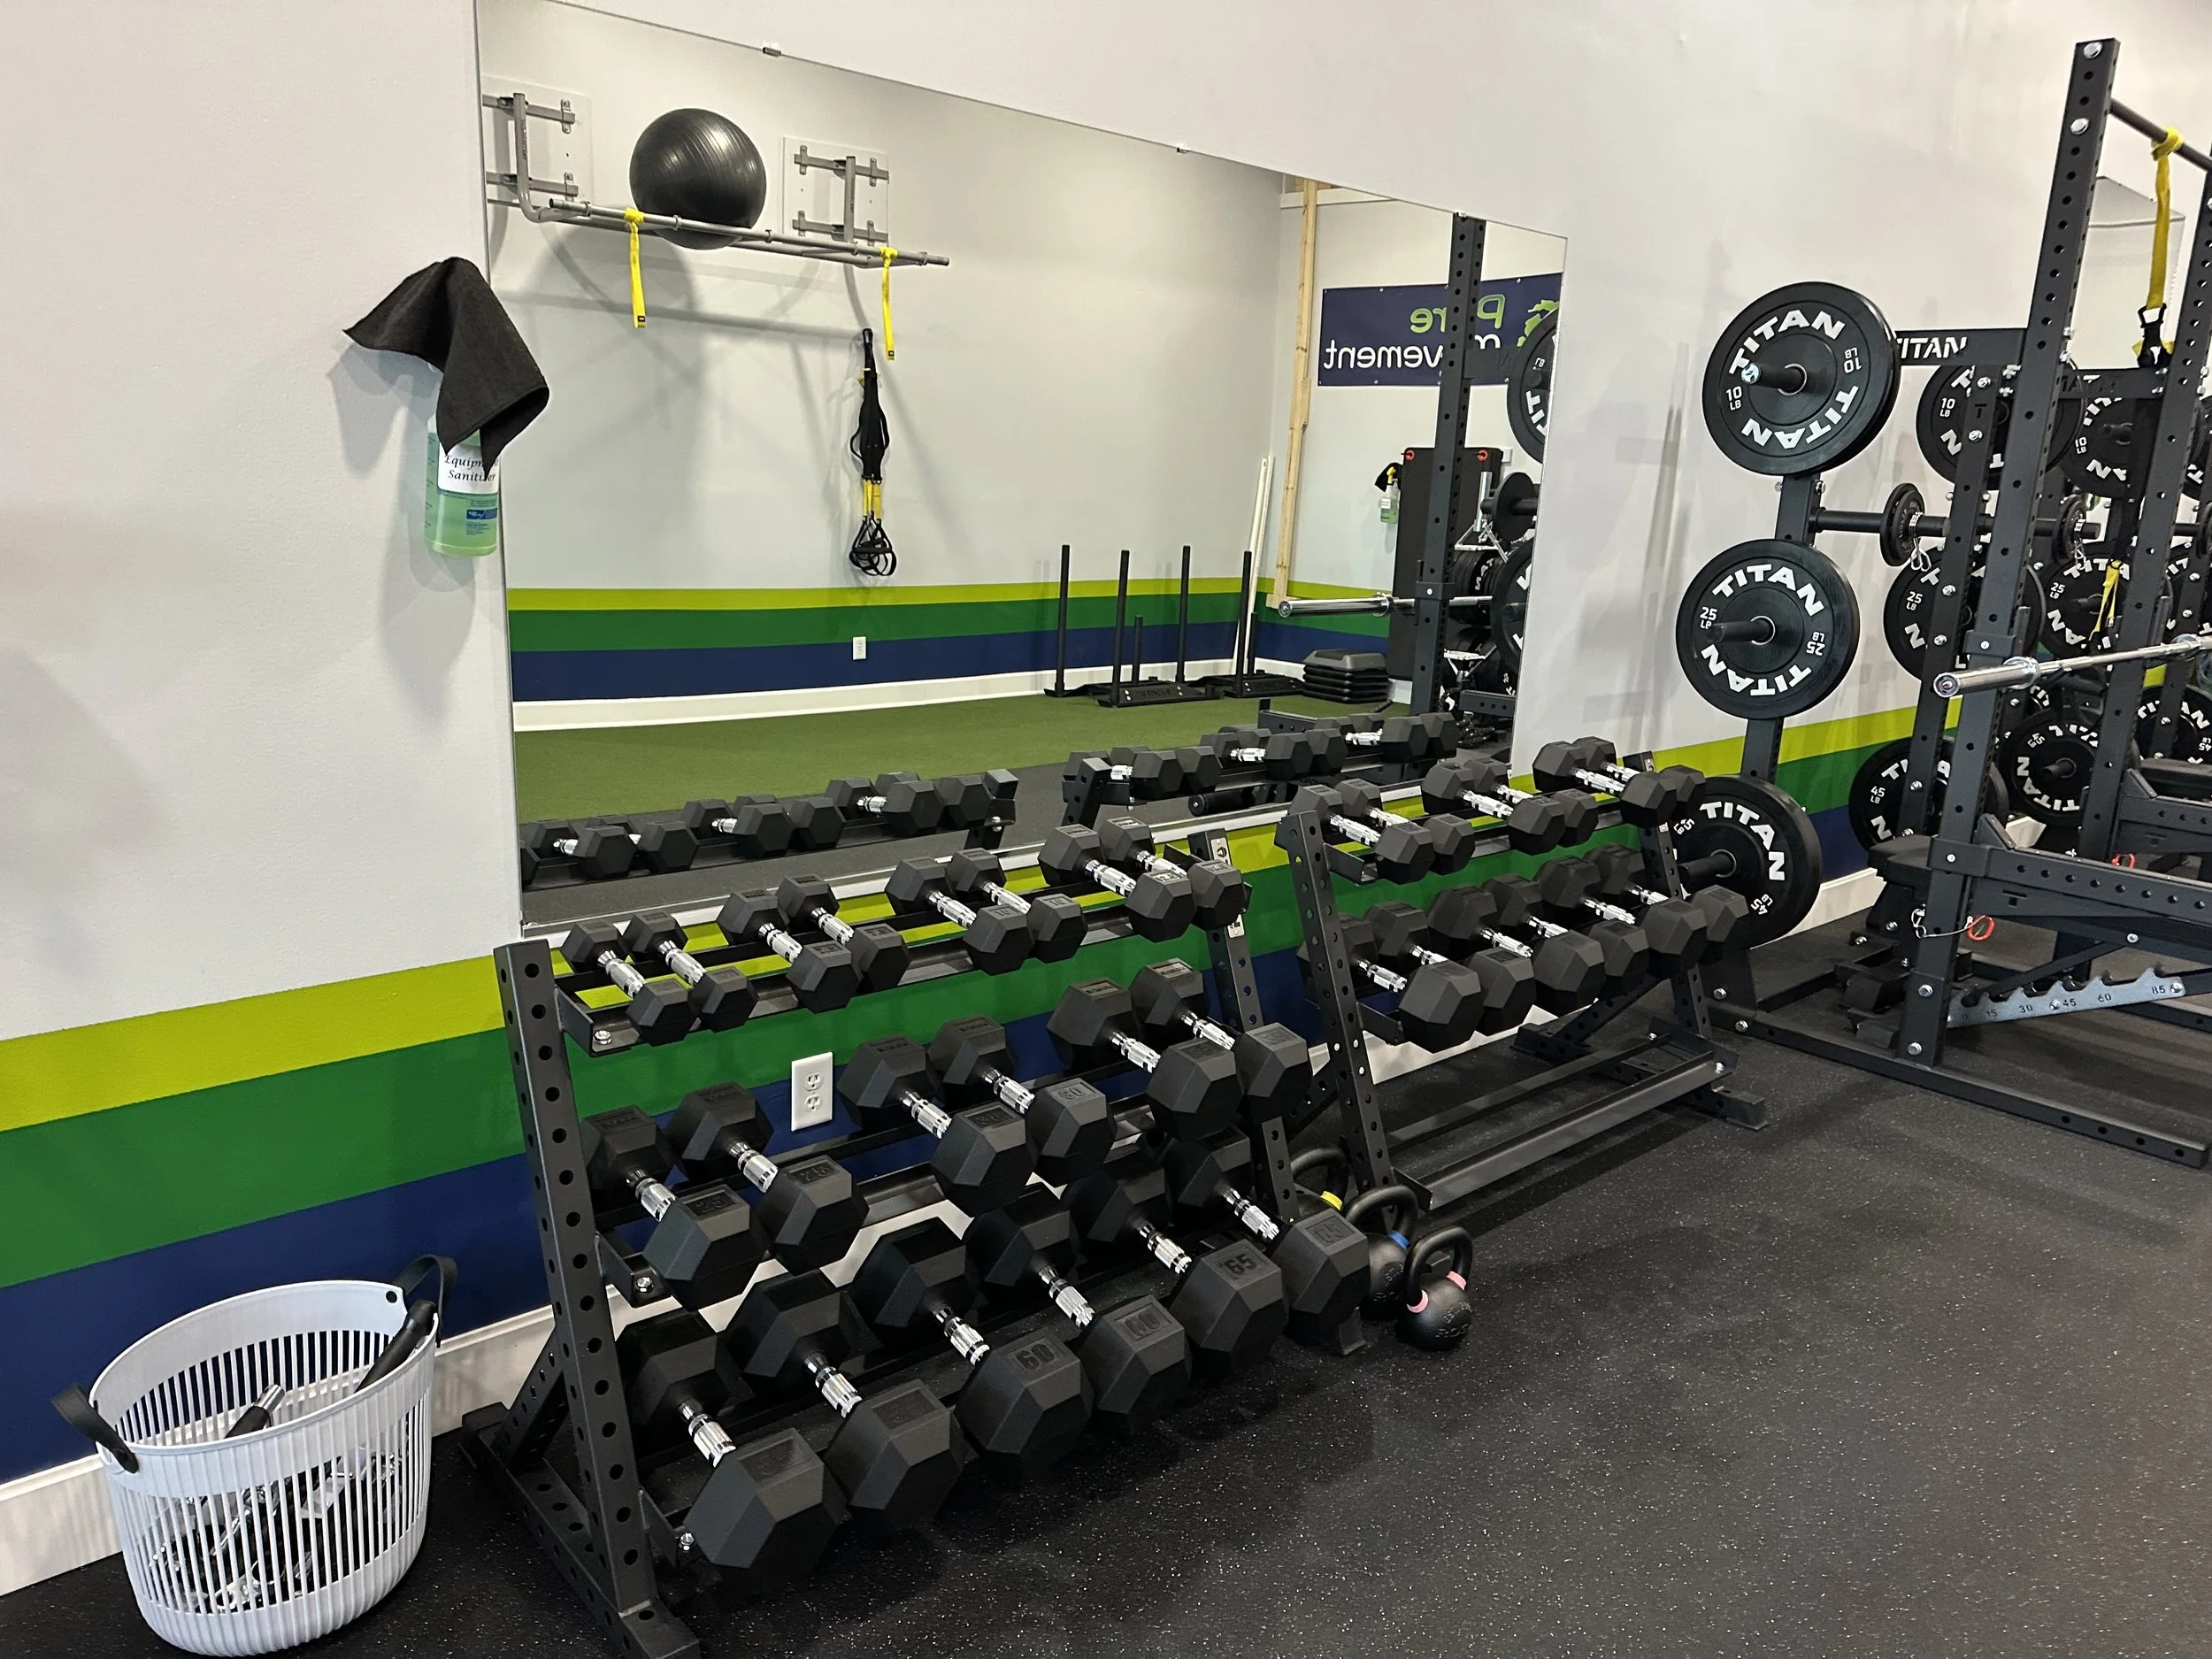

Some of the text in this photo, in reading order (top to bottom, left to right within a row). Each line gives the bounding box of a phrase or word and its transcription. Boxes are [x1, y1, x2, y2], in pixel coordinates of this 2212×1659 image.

[1729, 310, 1846, 374] TITAN
[1897, 337, 1967, 358] ITAN
[1845, 348, 1858, 358] LB
[1844, 359, 1862, 373] 10
[1726, 387, 1742, 401] 10
[1730, 400, 1742, 411] LB
[1942, 398, 1955, 409] 10
[1741, 386, 1858, 449] TITAN
[2076, 437, 2087, 448] 10
[1712, 565, 1824, 616] TITAN
[2051, 582, 2065, 593] 25
[1907, 591, 1923, 603] 25
[1700, 607, 1717, 620] 25
[1813, 631, 1824, 641] LB
[1807, 641, 1825, 656] 25
[1701, 644, 1812, 695] TITAN
[2017, 757, 2080, 811] TITAN
[1871, 786, 1886, 797] 45
[1699, 802, 1786, 880] TITAN
[1751, 898, 1768, 915] 45
[1761, 894, 1773, 907] LB
[2019, 1004, 2033, 1014] 30
[2062, 998, 2077, 1008] 45
[2098, 993, 2112, 1003] 60
[2151, 985, 2166, 995] 85
[1224, 1254, 1257, 1275] 65
[1017, 1344, 1055, 1370] 60
